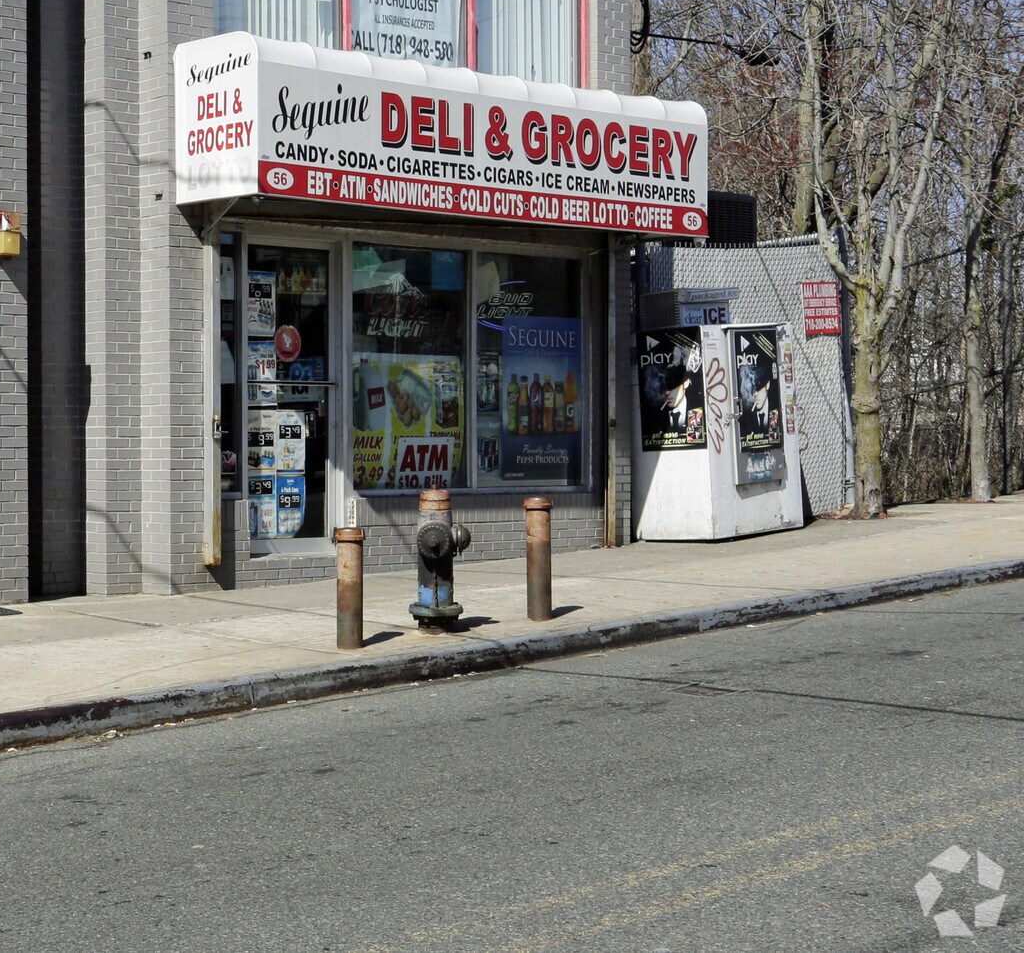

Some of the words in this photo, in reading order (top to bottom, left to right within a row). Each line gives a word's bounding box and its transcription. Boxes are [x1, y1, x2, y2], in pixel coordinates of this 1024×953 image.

[382, 14, 411, 28] INSURANCES
[411, 17, 435, 31] ACCEPTED
[377, 31, 407, 60] (718)
[186, 51, 252, 87] Seguine
[197, 90, 227, 122] DELI
[232, 87, 243, 115] &
[187, 119, 254, 157] GROCERY
[272, 83, 372, 141] Seguine
[381, 91, 474, 158] DELI
[484, 105, 514, 162] &
[521, 110, 698, 182] GROCERY
[273, 172, 288, 186] 56
[275, 140, 329, 165] CANDY
[337, 149, 377, 171] SODA
[387, 155, 475, 181] CIGARETTES
[483, 166, 534, 188] CIGARS
[541, 172, 562, 190] ICE
[566, 174, 610, 195] CREAM
[617, 181, 696, 205] NEWSPAPERS
[307, 169, 333, 197] EBT
[339, 176, 366, 201] ATM
[373, 177, 453, 210] SANDWICHES
[459, 187, 491, 213] COLD
[493, 191, 524, 217] CUTS
[530, 195, 559, 220] COLD
[562, 199, 590, 223] BEER
[592, 202, 629, 226] LOTTO
[634, 205, 673, 230] COFFEE
[687, 215, 698, 227] 56
[489, 291, 534, 306] BUD
[690, 290, 726, 302] packaged
[476, 304, 534, 319] LIGHT
[684, 313, 702, 324] clear
[703, 307, 727, 325] ICE
[805, 308, 816, 317] FREE
[509, 325, 576, 348] SEGUINE
[640, 351, 673, 368] play
[736, 352, 759, 369] play
[353, 436, 383, 449] MILK
[644, 438, 687, 446] SATISFACTION
[741, 438, 768, 447] SATISFACTION
[353, 453, 382, 463] GALLON
[399, 444, 449, 472] ATM
[516, 455, 534, 464] PEPSI
[535, 455, 570, 464] PRODUCTS
[424, 474, 447, 488] Bills
